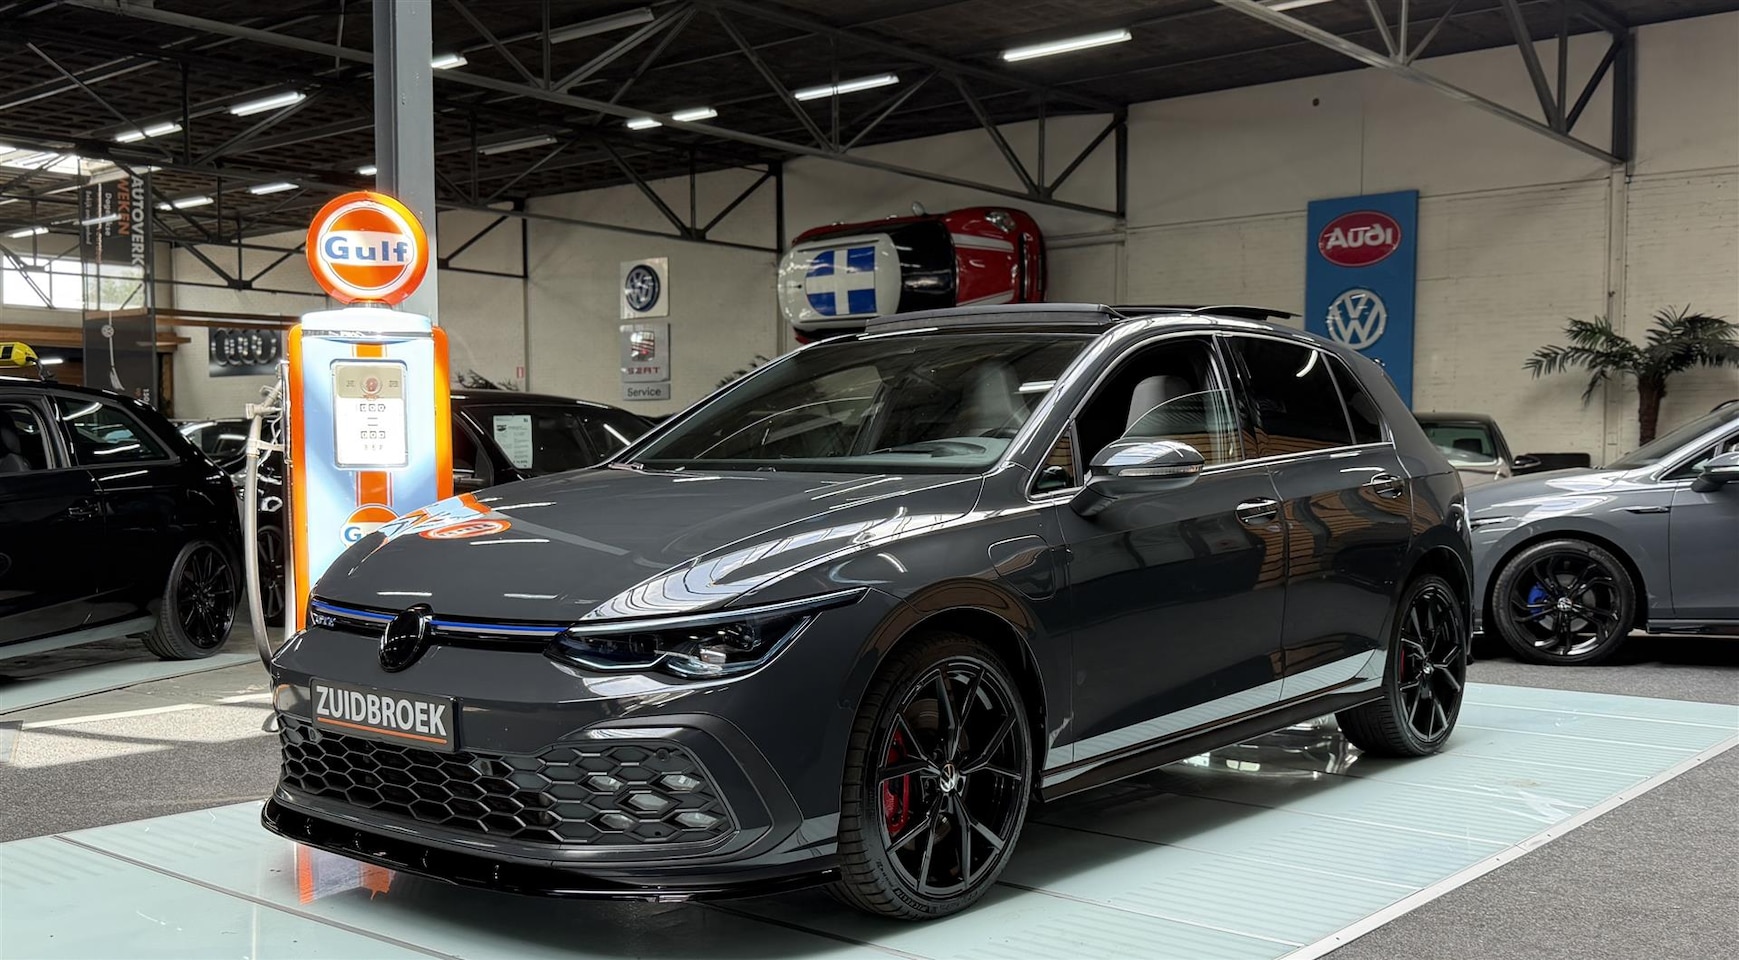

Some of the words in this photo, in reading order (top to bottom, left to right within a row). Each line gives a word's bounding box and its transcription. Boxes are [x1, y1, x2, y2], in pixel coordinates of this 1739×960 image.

[324, 236, 408, 262] Gulf
[627, 387, 662, 397] Service
[316, 685, 447, 737] ZUIDBROEK
